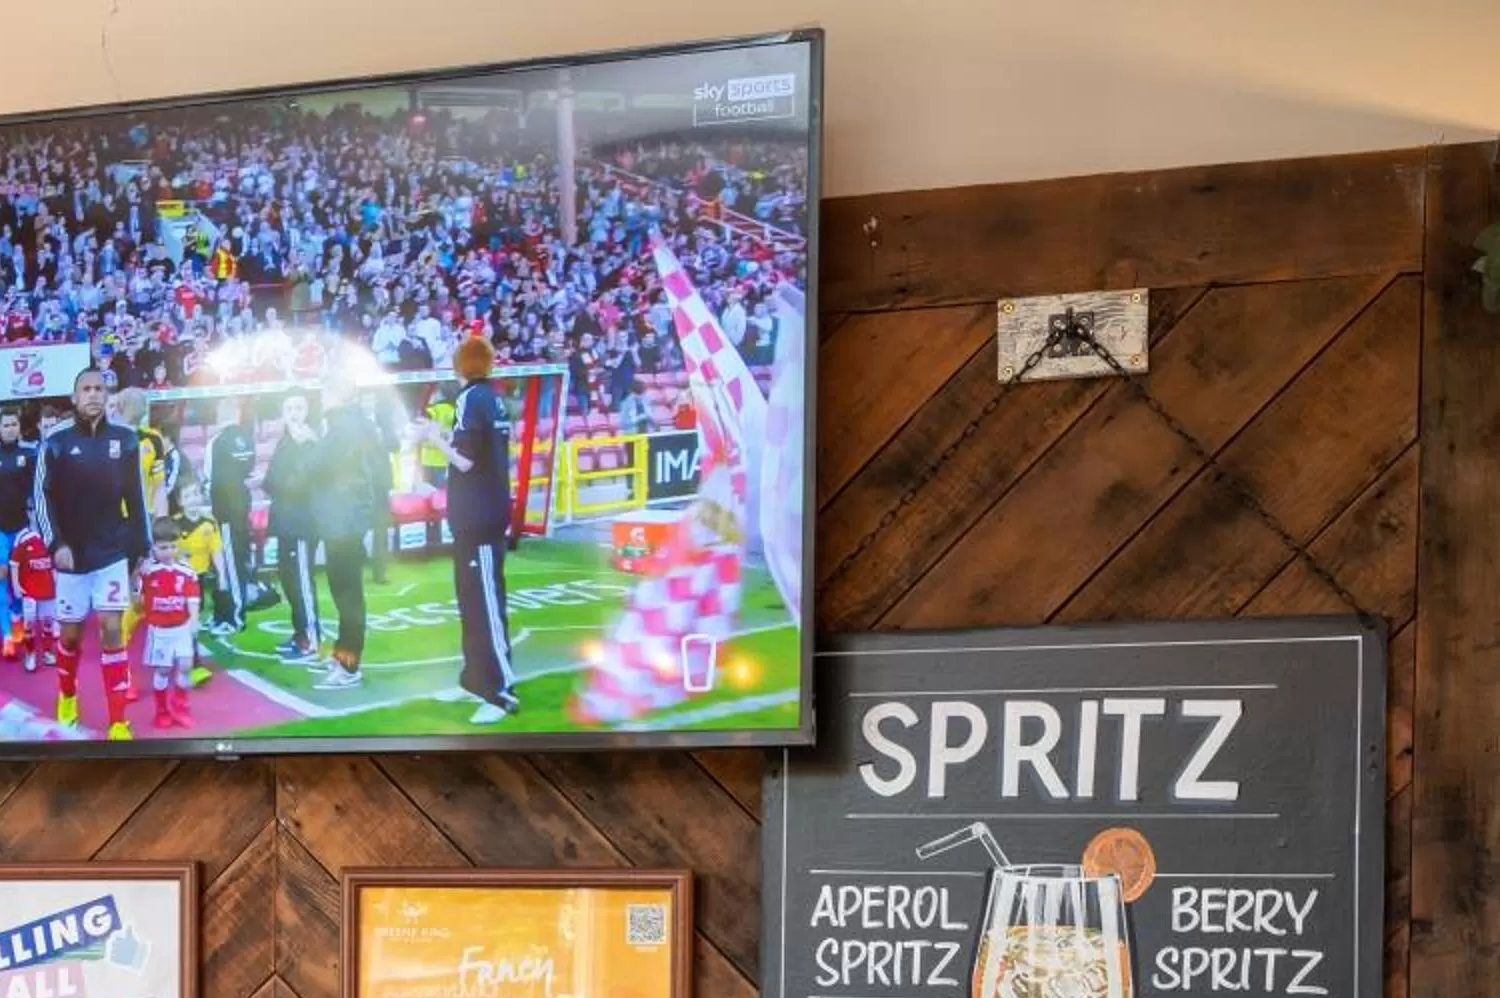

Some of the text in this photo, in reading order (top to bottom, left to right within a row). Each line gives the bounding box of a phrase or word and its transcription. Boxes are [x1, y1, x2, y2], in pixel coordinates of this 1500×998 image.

[693, 80, 725, 102] sky
[859, 698, 1243, 801] SPRITZ
[810, 885, 969, 929] APEROL
[1171, 886, 1319, 935] BERRY
[459, 945, 555, 998] Fancy
[815, 938, 961, 987] SPRITZ
[1152, 946, 1329, 995] SPRITZ
